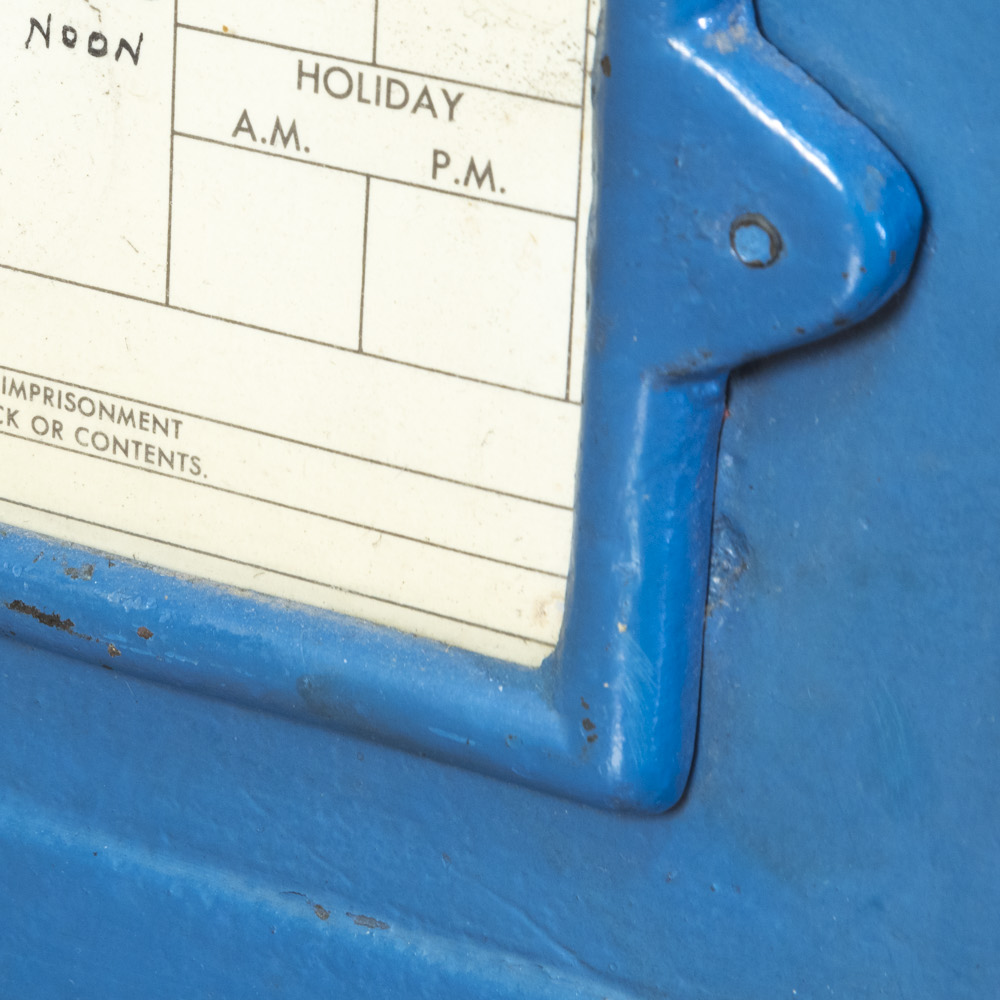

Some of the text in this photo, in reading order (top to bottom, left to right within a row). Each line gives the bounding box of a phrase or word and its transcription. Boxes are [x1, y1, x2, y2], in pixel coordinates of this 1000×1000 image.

[297, 59, 464, 122] HOLIDAY
[232, 108, 311, 154] A.M.
[432, 148, 507, 194] P.M.
[1, 374, 184, 440] IMPRISONMENT
[30, 414, 66, 442] OR
[75, 425, 211, 480] CONTENTS.
